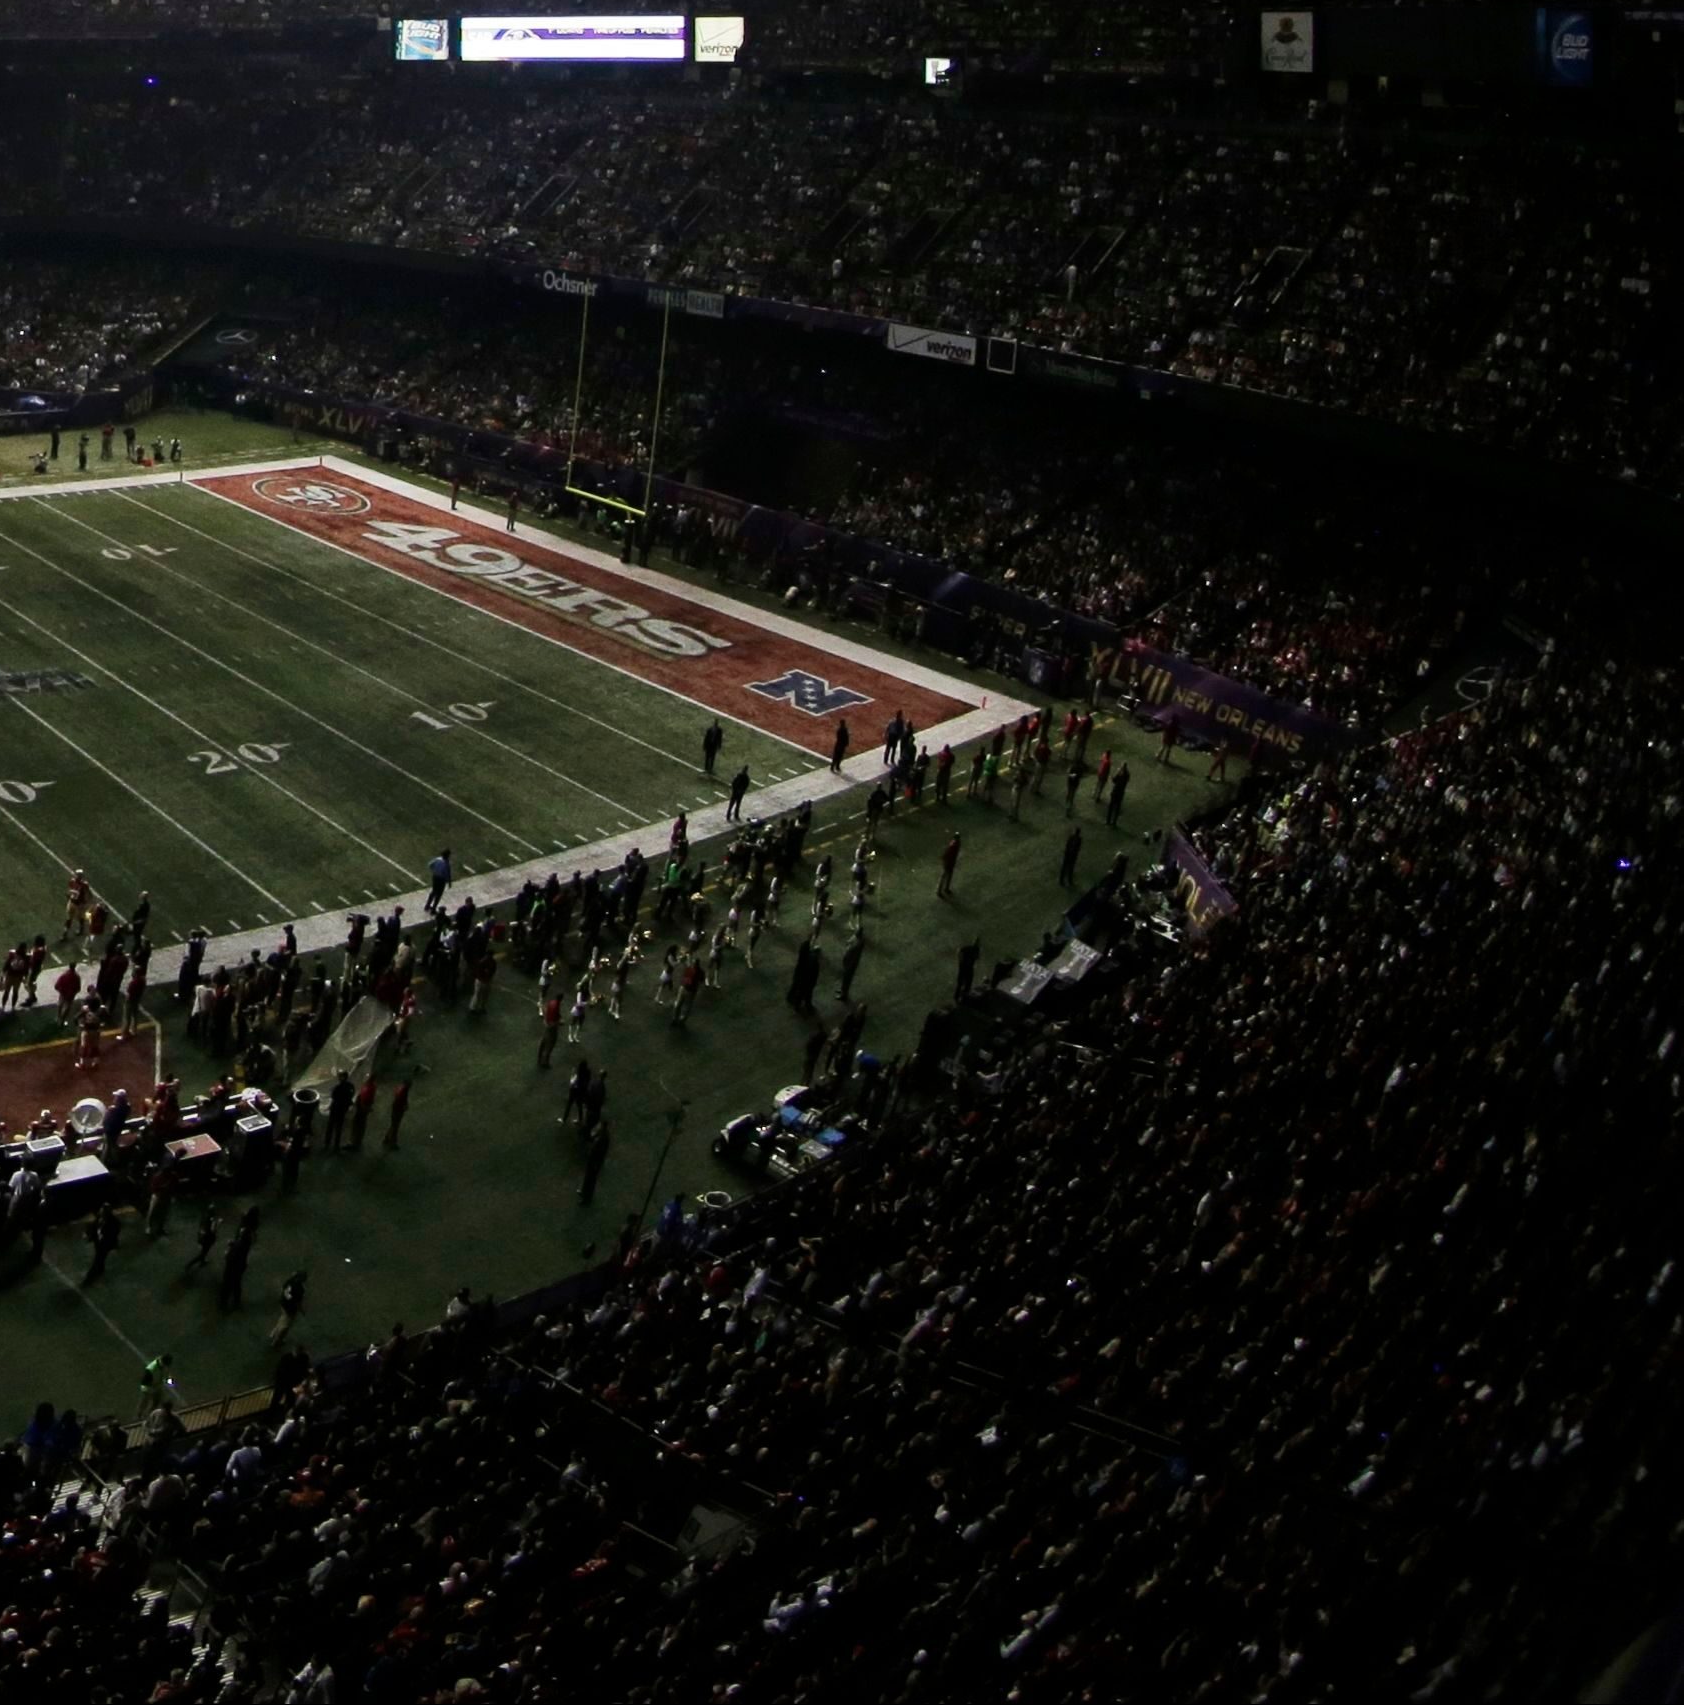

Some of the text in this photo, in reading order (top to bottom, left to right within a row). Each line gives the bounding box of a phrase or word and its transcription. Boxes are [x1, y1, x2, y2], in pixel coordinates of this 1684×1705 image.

[407, 29, 442, 40] LIGHT
[413, 20, 440, 31] BUD
[1561, 34, 1589, 46] BUD
[701, 43, 739, 57] verizon
[1555, 47, 1590, 60] LIGHT
[927, 340, 970, 360] verizon
[100, 543, 166, 561] 10
[361, 519, 732, 661] 49ERS
[410, 702, 488, 729] 10
[1174, 688, 1213, 715] NEW
[1215, 704, 1305, 752] ORLEANS
[187, 742, 282, 776] 20
